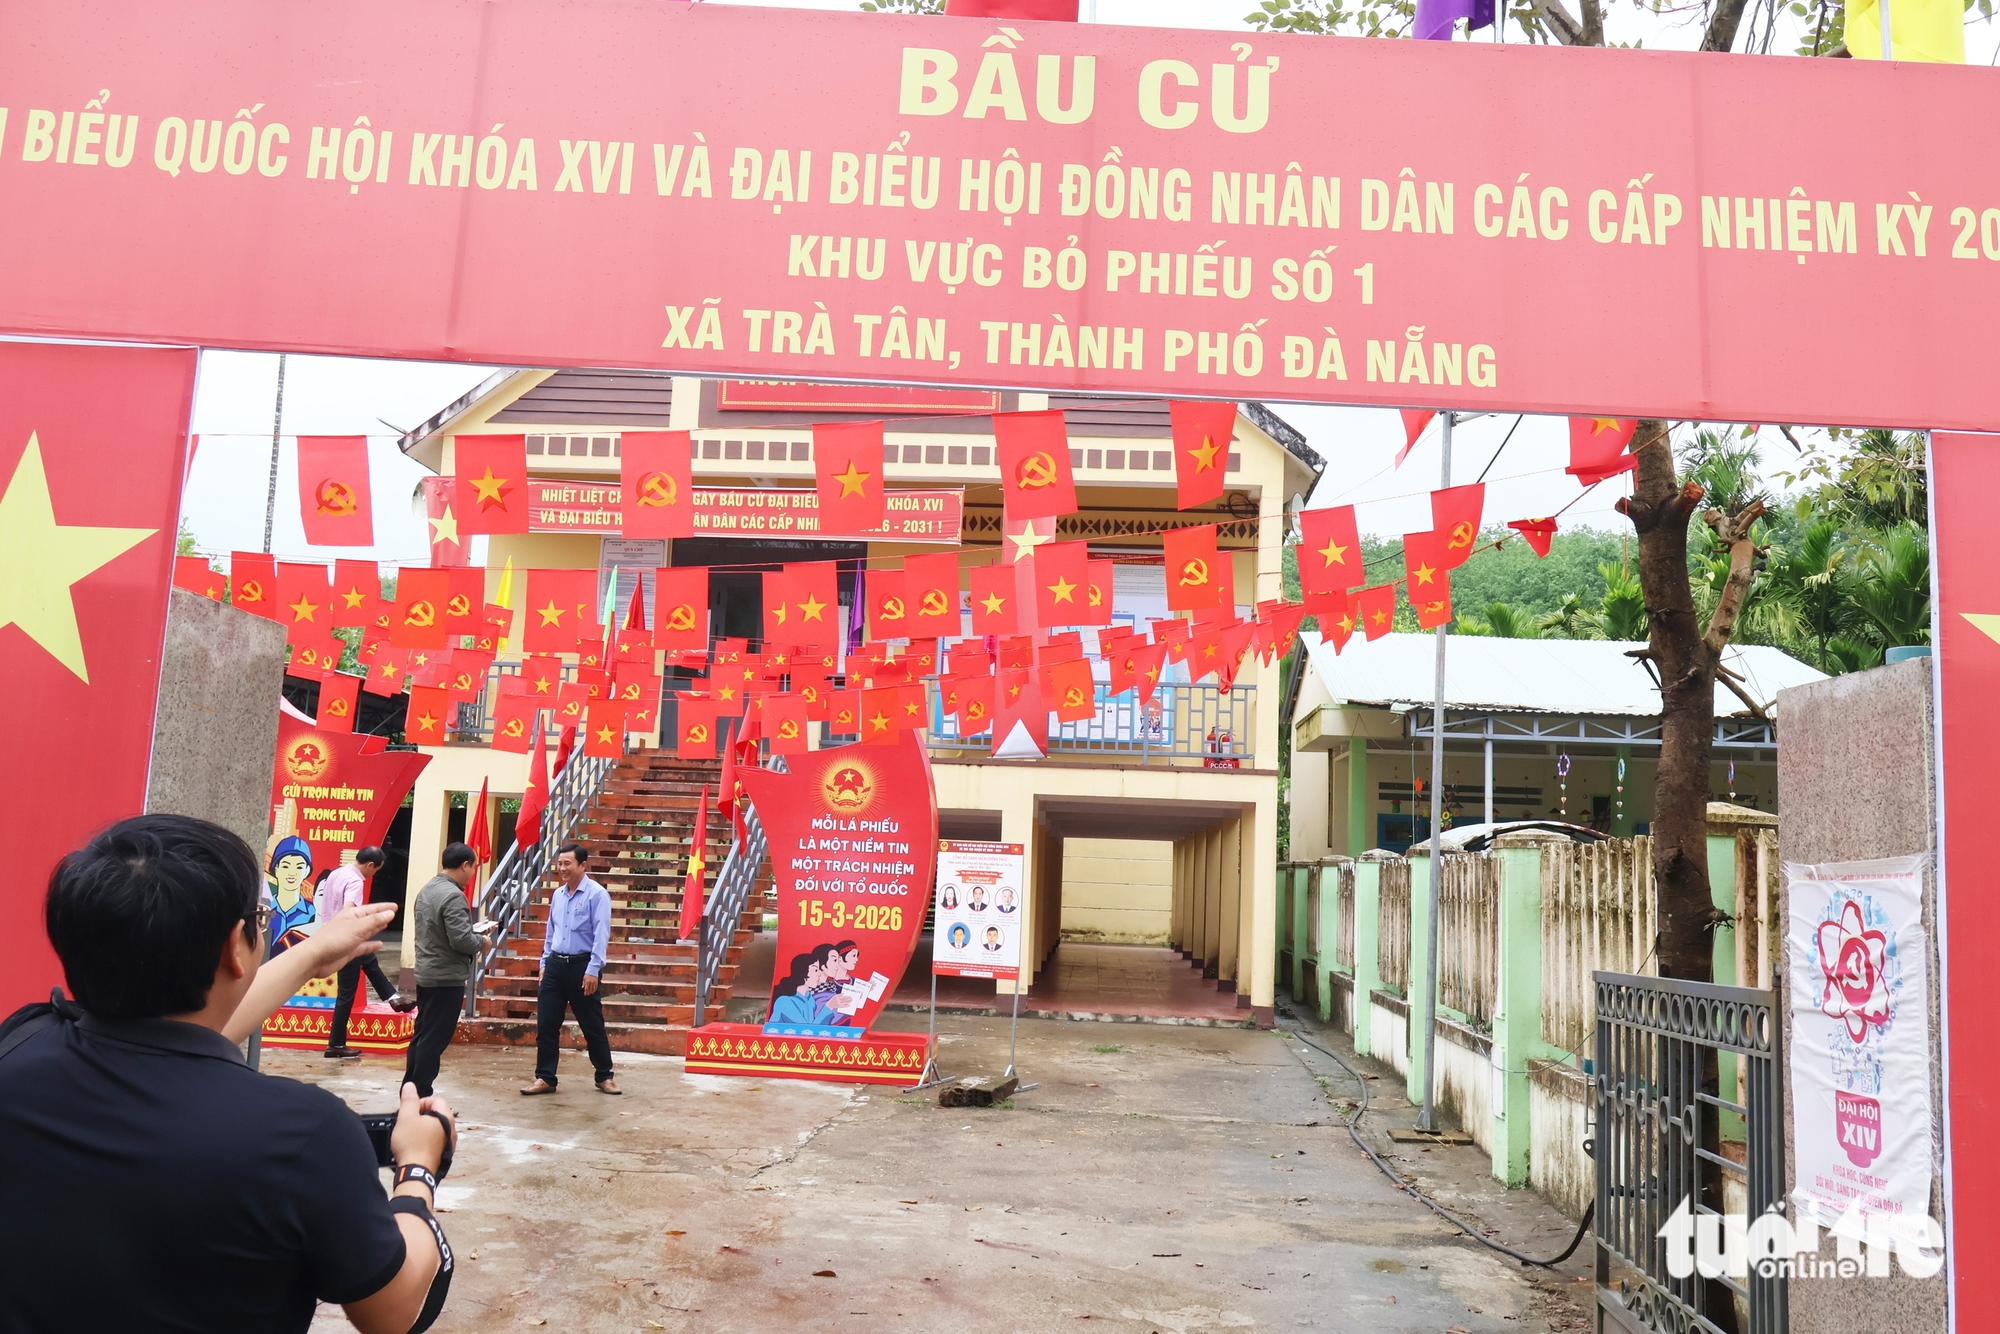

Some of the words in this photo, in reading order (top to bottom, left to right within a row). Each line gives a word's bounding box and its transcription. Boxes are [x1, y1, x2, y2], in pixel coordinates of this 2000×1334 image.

[898, 26, 1096, 125] BẦU
[1138, 42, 1280, 134] CỬ
[22, 88, 139, 168] BIỂU
[154, 102, 290, 178] QUỐC
[306, 115, 393, 195] HỘI
[408, 122, 538, 191] KHÓA
[553, 139, 635, 195] XVI
[652, 131, 713, 198] VÀ
[729, 147, 812, 215] ĐẠI
[829, 130, 941, 210] BIỂU
[958, 147, 1042, 227] HỘI
[1058, 145, 1192, 222] ĐỒNG
[1211, 161, 1341, 229] NHÂN
[1360, 167, 1454, 235] DÂN
[1473, 172, 1569, 241] CÁC
[1588, 172, 1683, 246] CẤP
[1701, 186, 1858, 265] NHIỆM
[1875, 191, 1933, 257] KỲ
[787, 234, 886, 281] KHU
[904, 237, 1003, 295] VỰC
[1022, 234, 1087, 291] BỎ
[1106, 239, 1252, 299] PHIẾU
[1271, 245, 1338, 303] SỐ
[1353, 262, 1374, 305] 1
[661, 297, 724, 351] XÃ
[742, 301, 836, 356] TRÀ
[853, 305, 961, 370] TÂN,
[980, 313, 1144, 371] THÀNH
[1164, 318, 1269, 377] PHỐ
[1281, 326, 1348, 381] ĐÀ
[1366, 325, 1497, 388] NẴNG
[541, 486, 577, 505] NHIỆT
[580, 487, 606, 506] LIỆT
[692, 490, 716, 506] GÀY
[767, 494, 788, 510] ĐẠI
[792, 490, 819, 509] BIỂU
[886, 494, 920, 511] KHÓA
[923, 498, 944, 512] XVI
[540, 507, 556, 524] VÀ
[559, 510, 580, 527] ĐẠI
[582, 506, 611, 526] BIỂU
[712, 512, 737, 529] DÂN
[740, 512, 765, 530] CÁC
[768, 512, 794, 530] CẤP
[902, 519, 933, 534] 2031
[938, 520, 943, 534] !
[302, 786, 330, 801] TRỌN
[330, 782, 355, 801] NIỀM
[357, 789, 374, 801] TIN
[303, 807, 337, 822] TRONG
[338, 807, 366, 823] TỪNG
[811, 813, 837, 831] MỖI
[839, 816, 857, 832] LÁ
[860, 816, 899, 834] PHIẾU
[309, 826, 321, 841] LÁ
[322, 824, 355, 843] PHIẾU
[798, 835, 816, 850] LÀ
[819, 836, 850, 855] MỘT
[852, 836, 885, 854] NIỀM
[888, 842, 909, 855] TIN
[791, 856, 822, 874] MỘT
[824, 857, 870, 874] TRÁCH
[873, 861, 915, 876] NHIỆM
[794, 874, 819, 892] ĐỐI
[821, 877, 845, 893] VỚI
[848, 876, 867, 894] TỔ
[868, 878, 909, 896] QUỐC
[797, 899, 903, 931] 15-3-2026
[1838, 1098, 1857, 1119] ĐẠI
[1859, 1102, 1878, 1125] HỘI
[1842, 1120, 1878, 1151] XIV
[1894, 1200, 1903, 1215] SỐ
